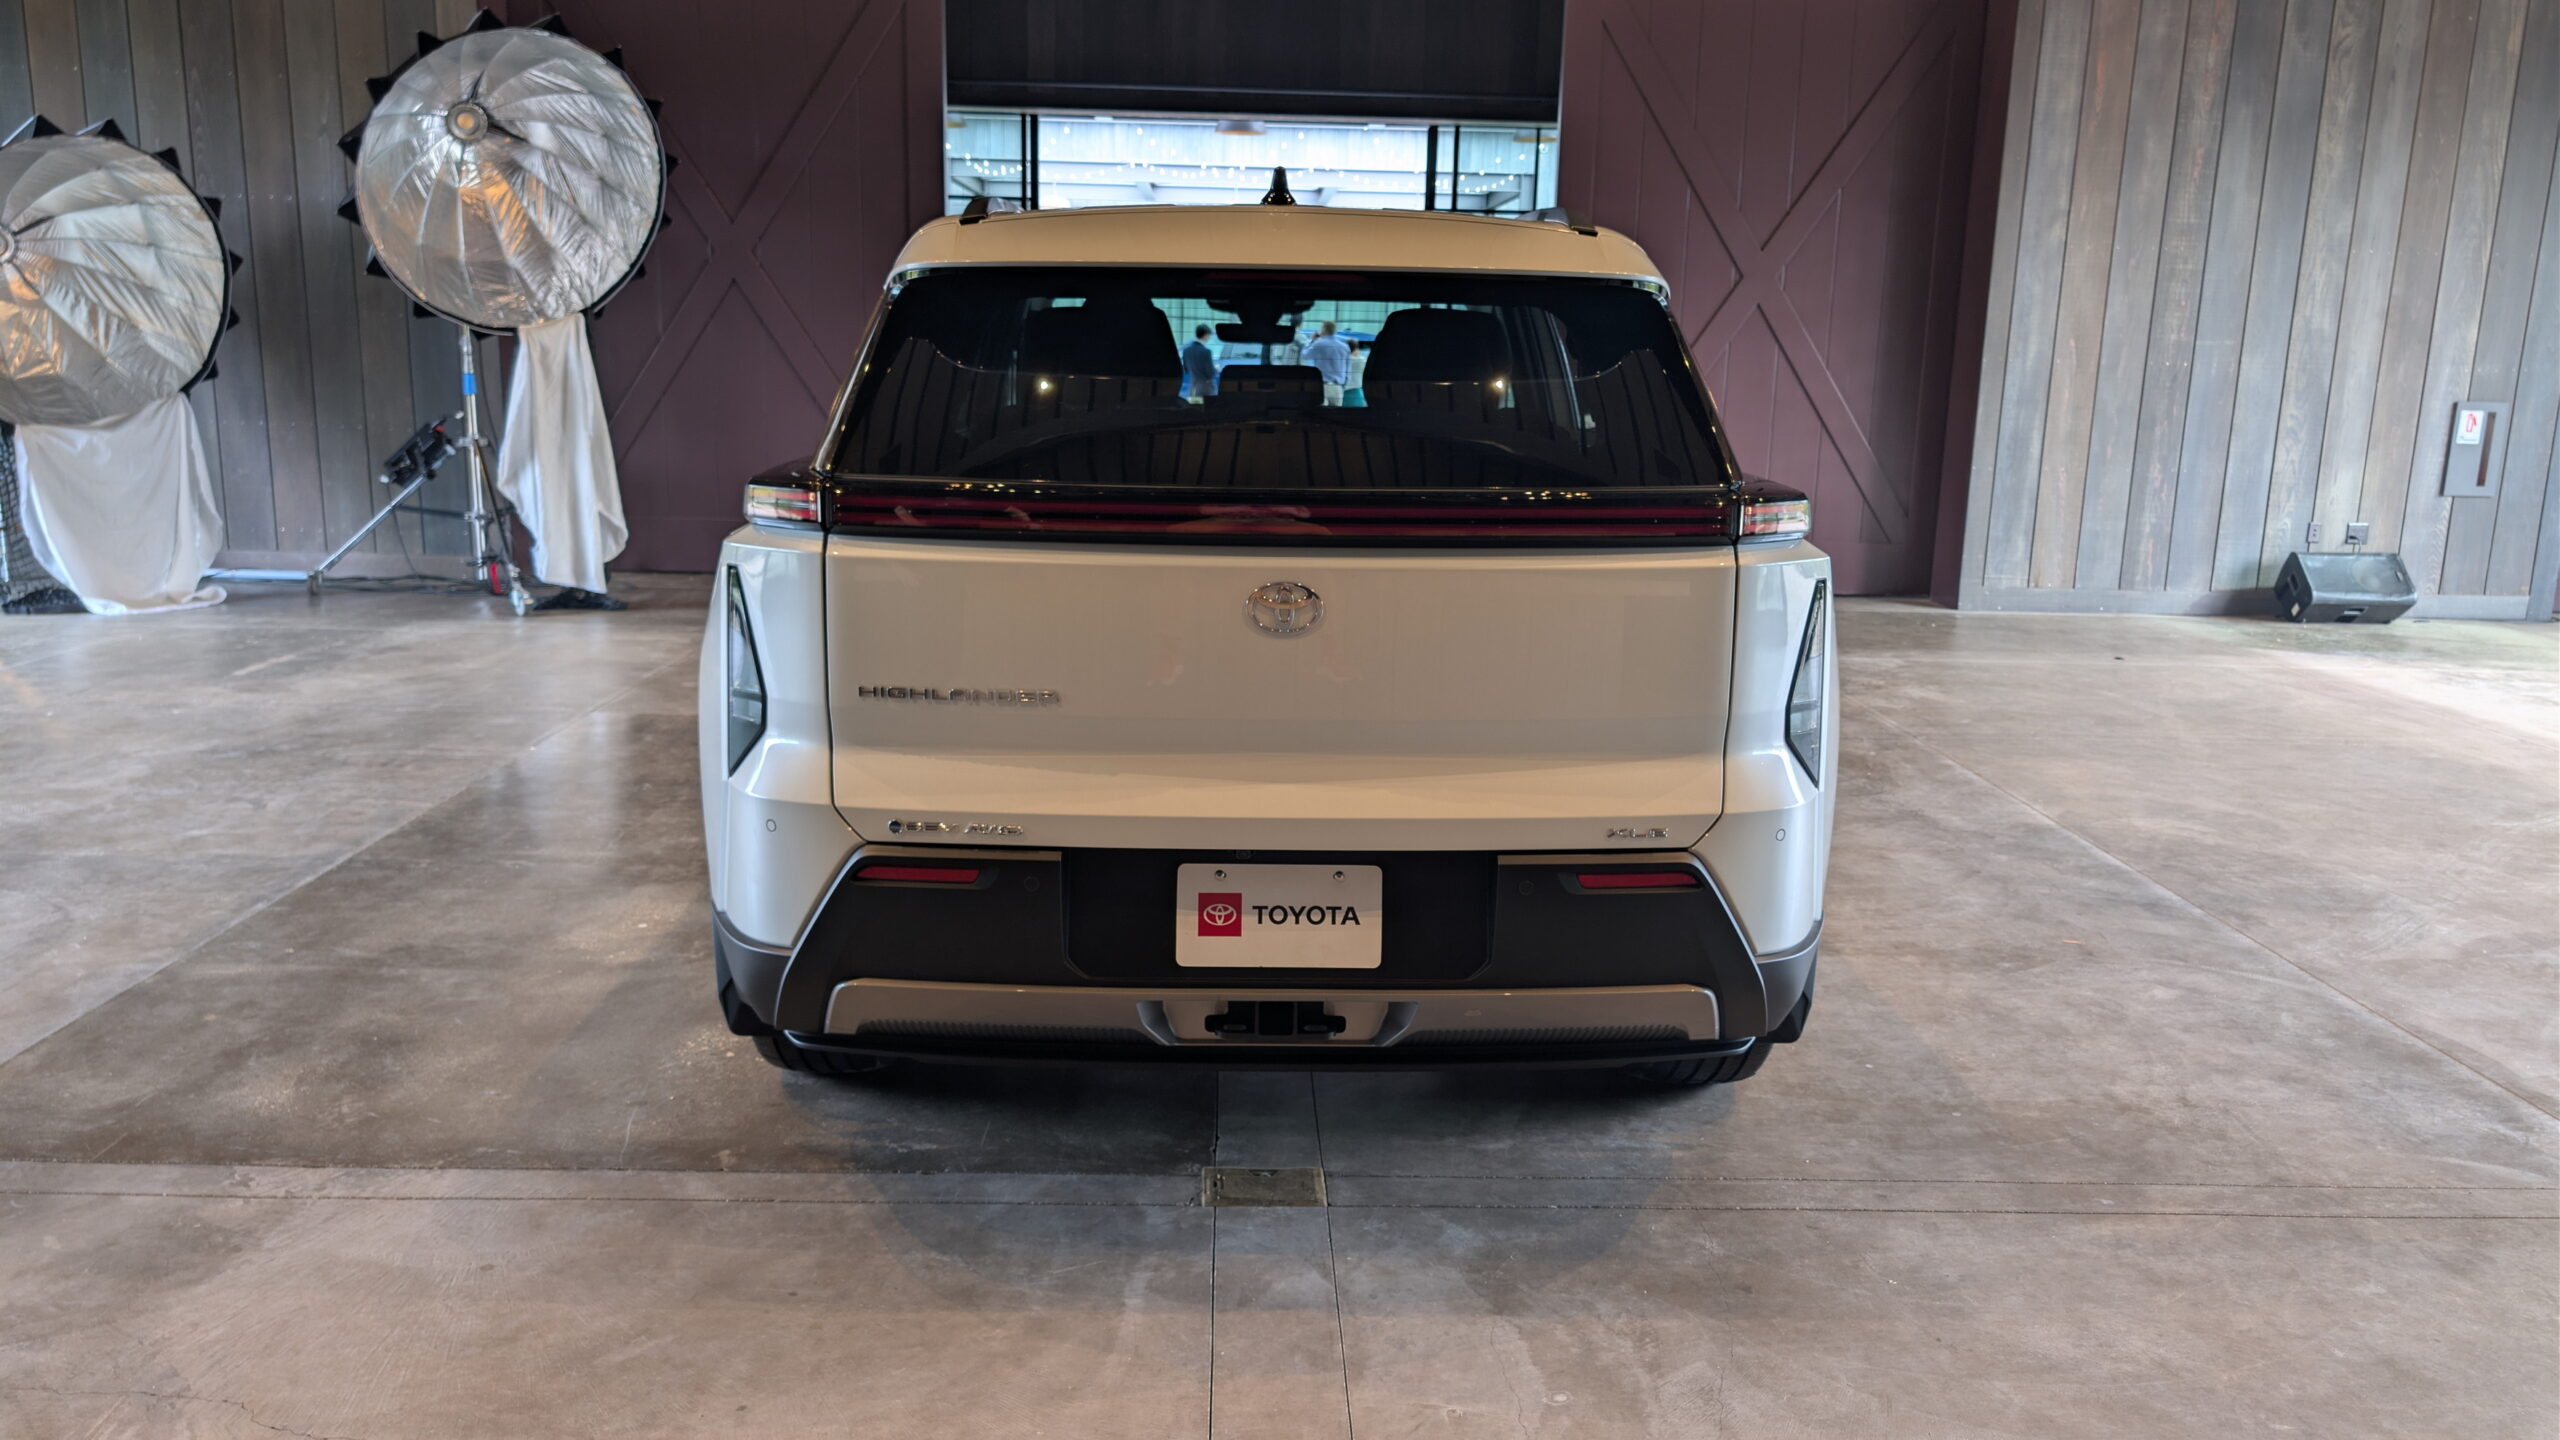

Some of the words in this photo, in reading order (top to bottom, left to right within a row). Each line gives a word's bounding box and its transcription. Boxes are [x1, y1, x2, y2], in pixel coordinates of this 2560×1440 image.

[858, 685, 1061, 704] HIGHLANDER
[1606, 828, 1669, 839] XLE
[1252, 905, 1360, 926] TOYOTA
